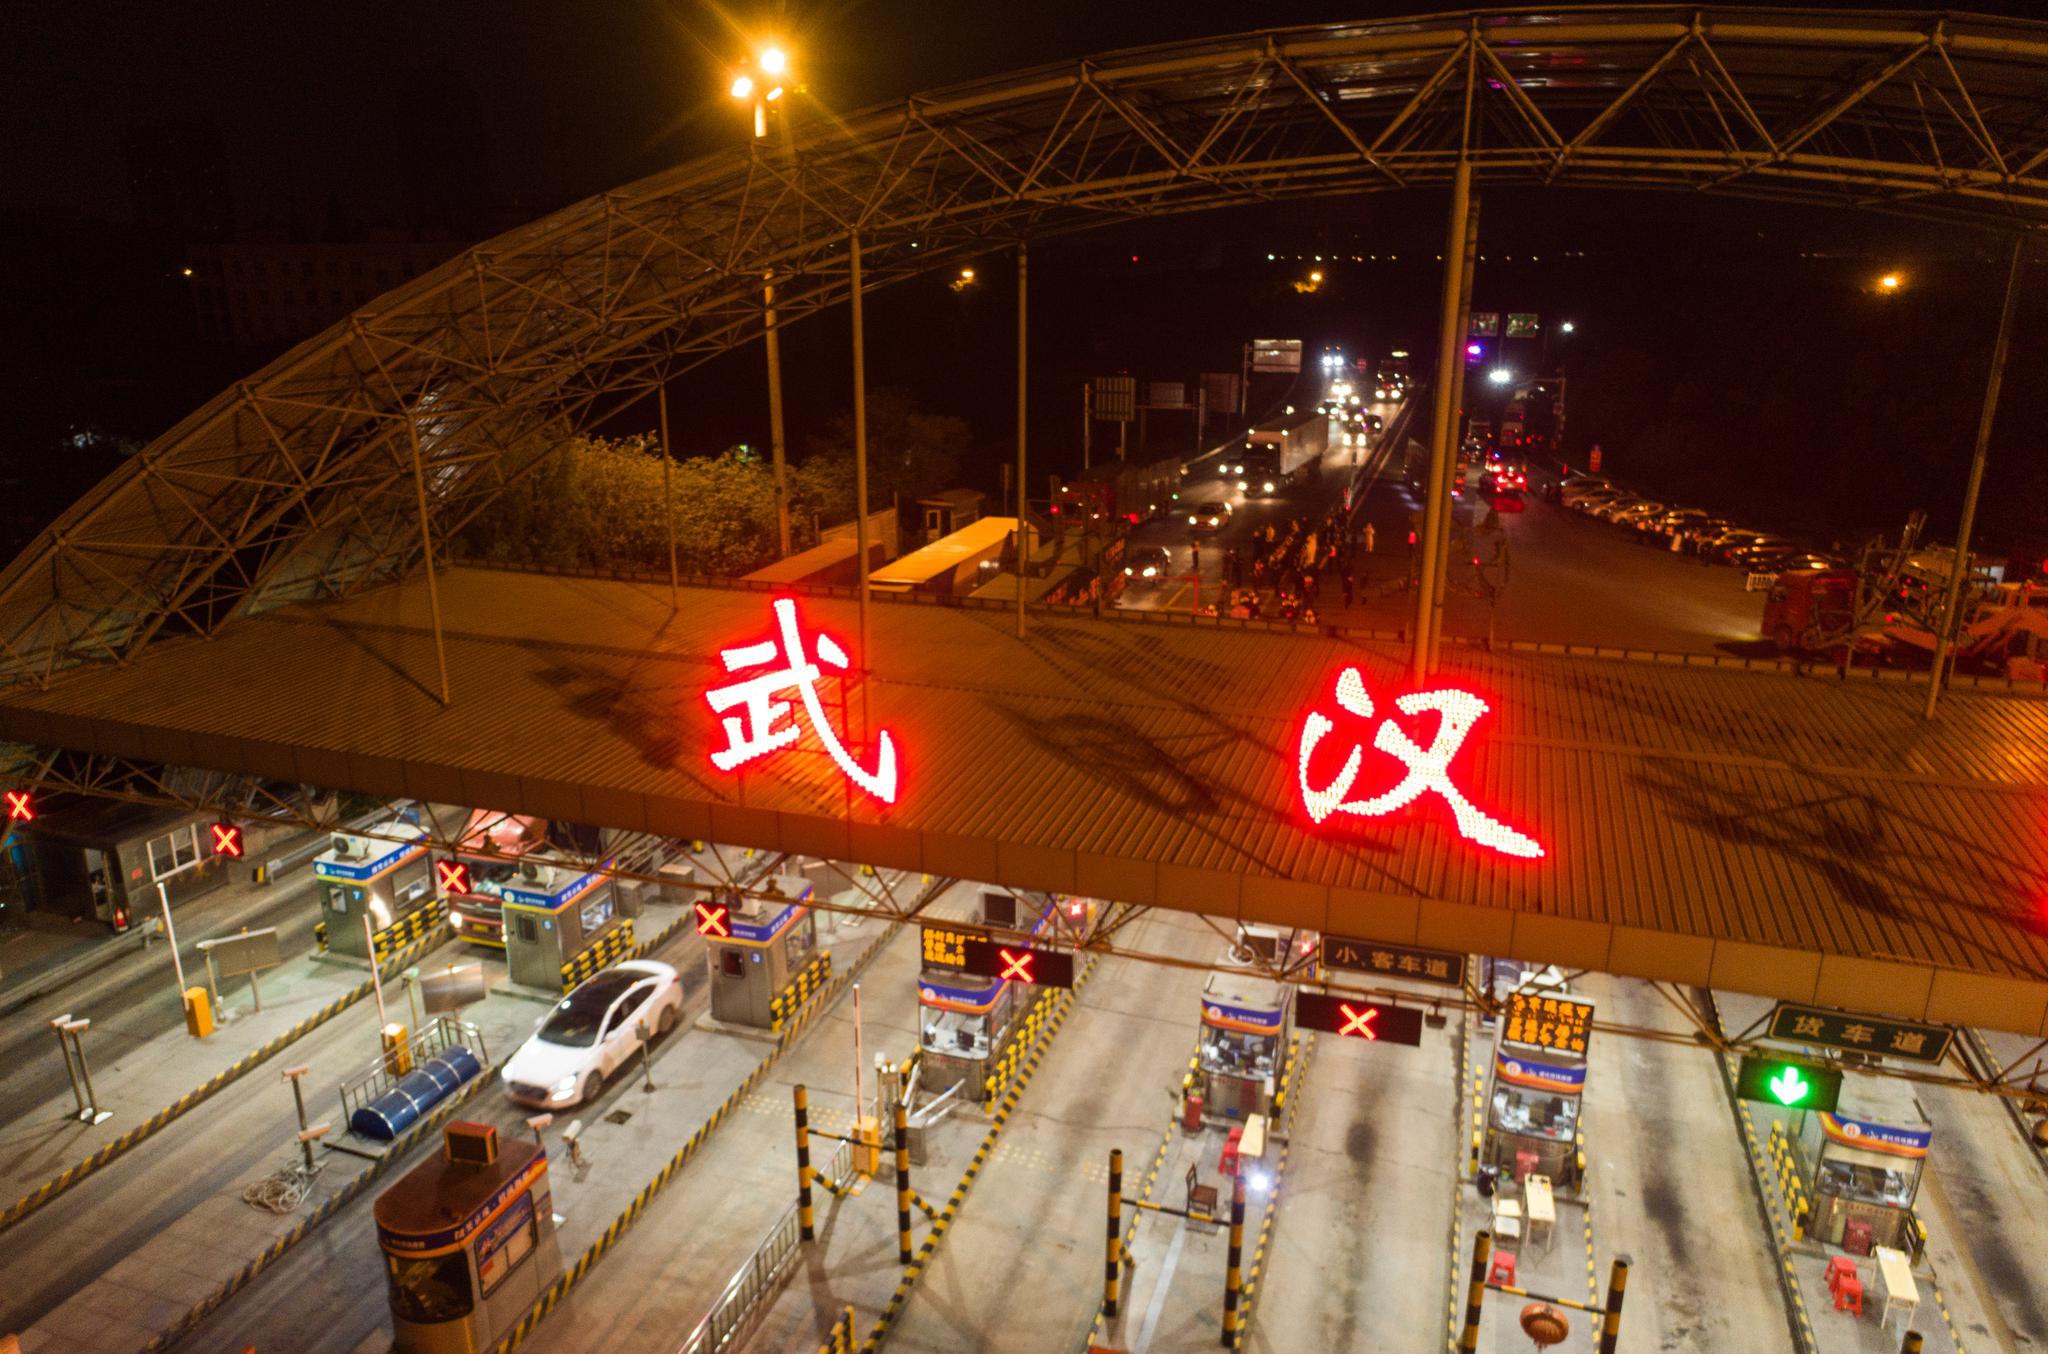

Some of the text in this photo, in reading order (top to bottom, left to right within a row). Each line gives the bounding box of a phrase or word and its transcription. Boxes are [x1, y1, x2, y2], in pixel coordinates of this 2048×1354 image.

[705, 598, 1545, 858] 武 汉
[1791, 1015, 1928, 1054] 货车道
